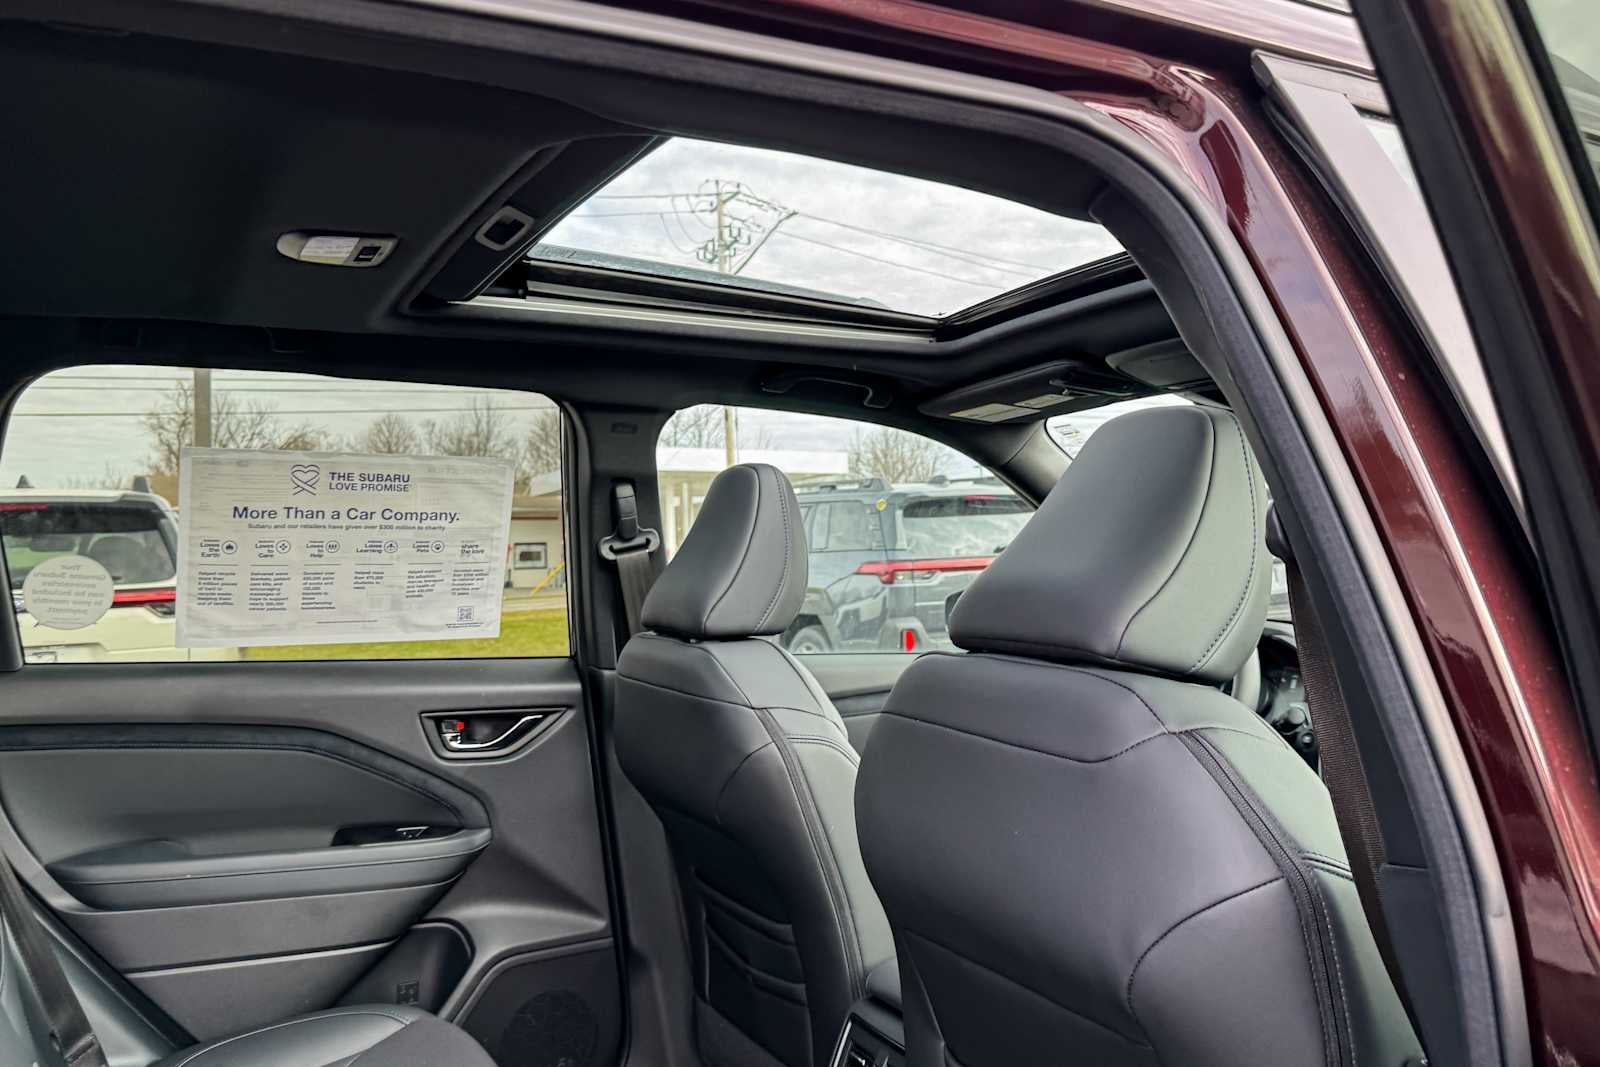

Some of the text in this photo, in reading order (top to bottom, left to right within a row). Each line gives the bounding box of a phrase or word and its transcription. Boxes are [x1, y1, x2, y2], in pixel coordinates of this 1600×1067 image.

[329, 472, 410, 483] THE SUBARU
[329, 482, 410, 493] LOVE PROMISE
[232, 506, 460, 524] More Than a Car Company.
